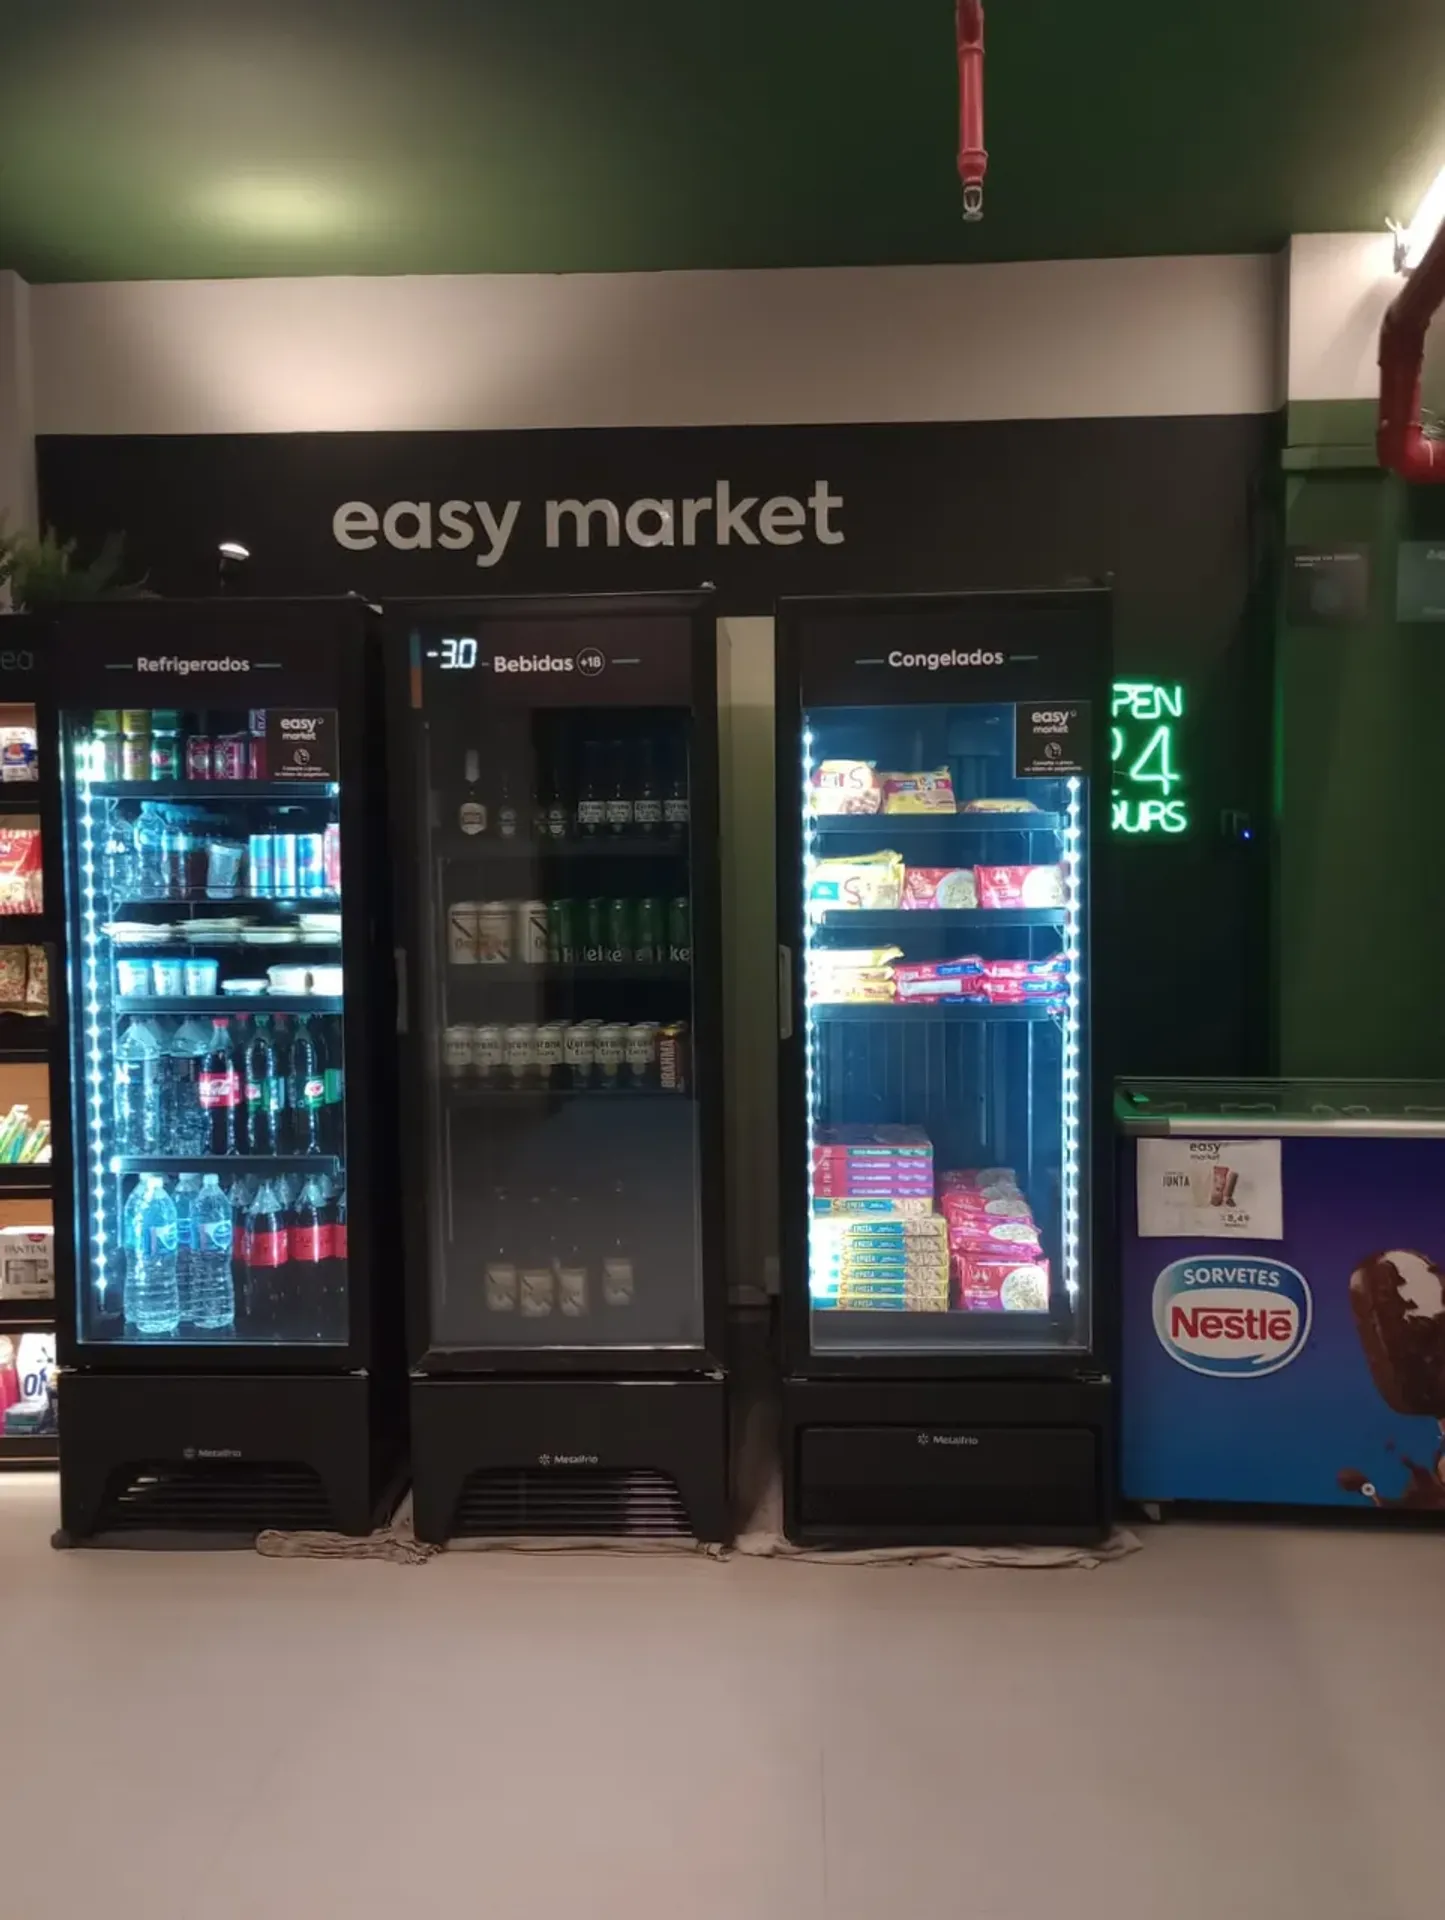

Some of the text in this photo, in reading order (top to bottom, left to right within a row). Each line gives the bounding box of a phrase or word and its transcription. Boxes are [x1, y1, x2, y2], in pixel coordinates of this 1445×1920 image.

[332, 479, 845, 567] easy market
[137, 655, 250, 675] Refrigerados
[493, 654, 602, 673] Bebidas +18
[888, 648, 1004, 671] Congelados
[1112, 683, 1182, 719] PEN
[280, 718, 316, 733] easy
[1031, 710, 1069, 726] easy
[282, 731, 316, 741] market
[1033, 724, 1069, 734] market
[1112, 799, 1188, 833] URS
[659, 1039, 677, 1089] BRAHMA
[1189, 1142, 1222, 1154] easy
[1184, 1267, 1280, 1287] SORVETES
